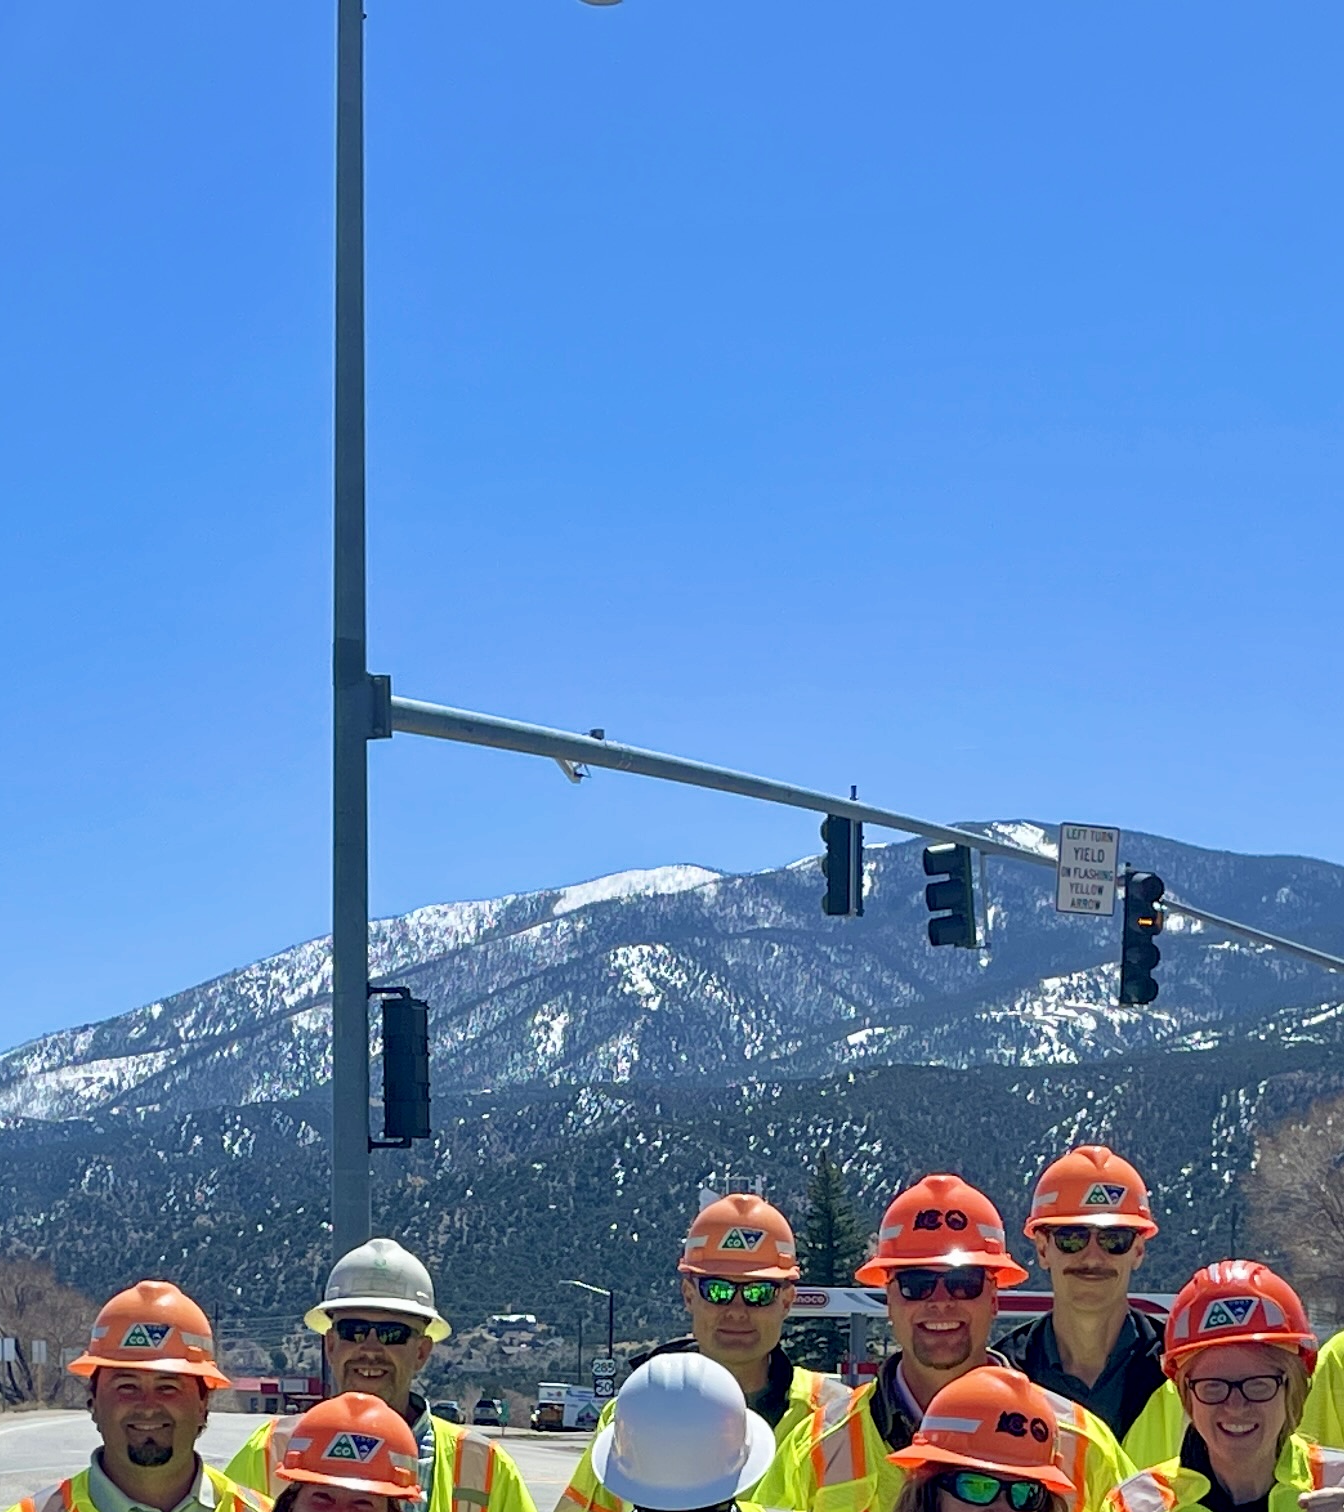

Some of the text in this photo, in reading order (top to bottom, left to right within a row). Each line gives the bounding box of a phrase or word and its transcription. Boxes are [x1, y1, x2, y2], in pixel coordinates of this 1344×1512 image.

[1066, 828, 1113, 842] LEFT TURN
[1073, 847, 1105, 863] YIELD
[1061, 866, 1071, 877] ON
[1069, 882, 1104, 896] YELLOW
[1070, 897, 1101, 910] ARROW
[1090, 1194, 1105, 1203] CO
[727, 1239, 741, 1248] CO
[1209, 1314, 1227, 1325] CO
[129, 1336, 145, 1345] CO
[594, 1362, 614, 1373] 285
[596, 1382, 611, 1393] 50
[334, 1446, 351, 1456] CO
